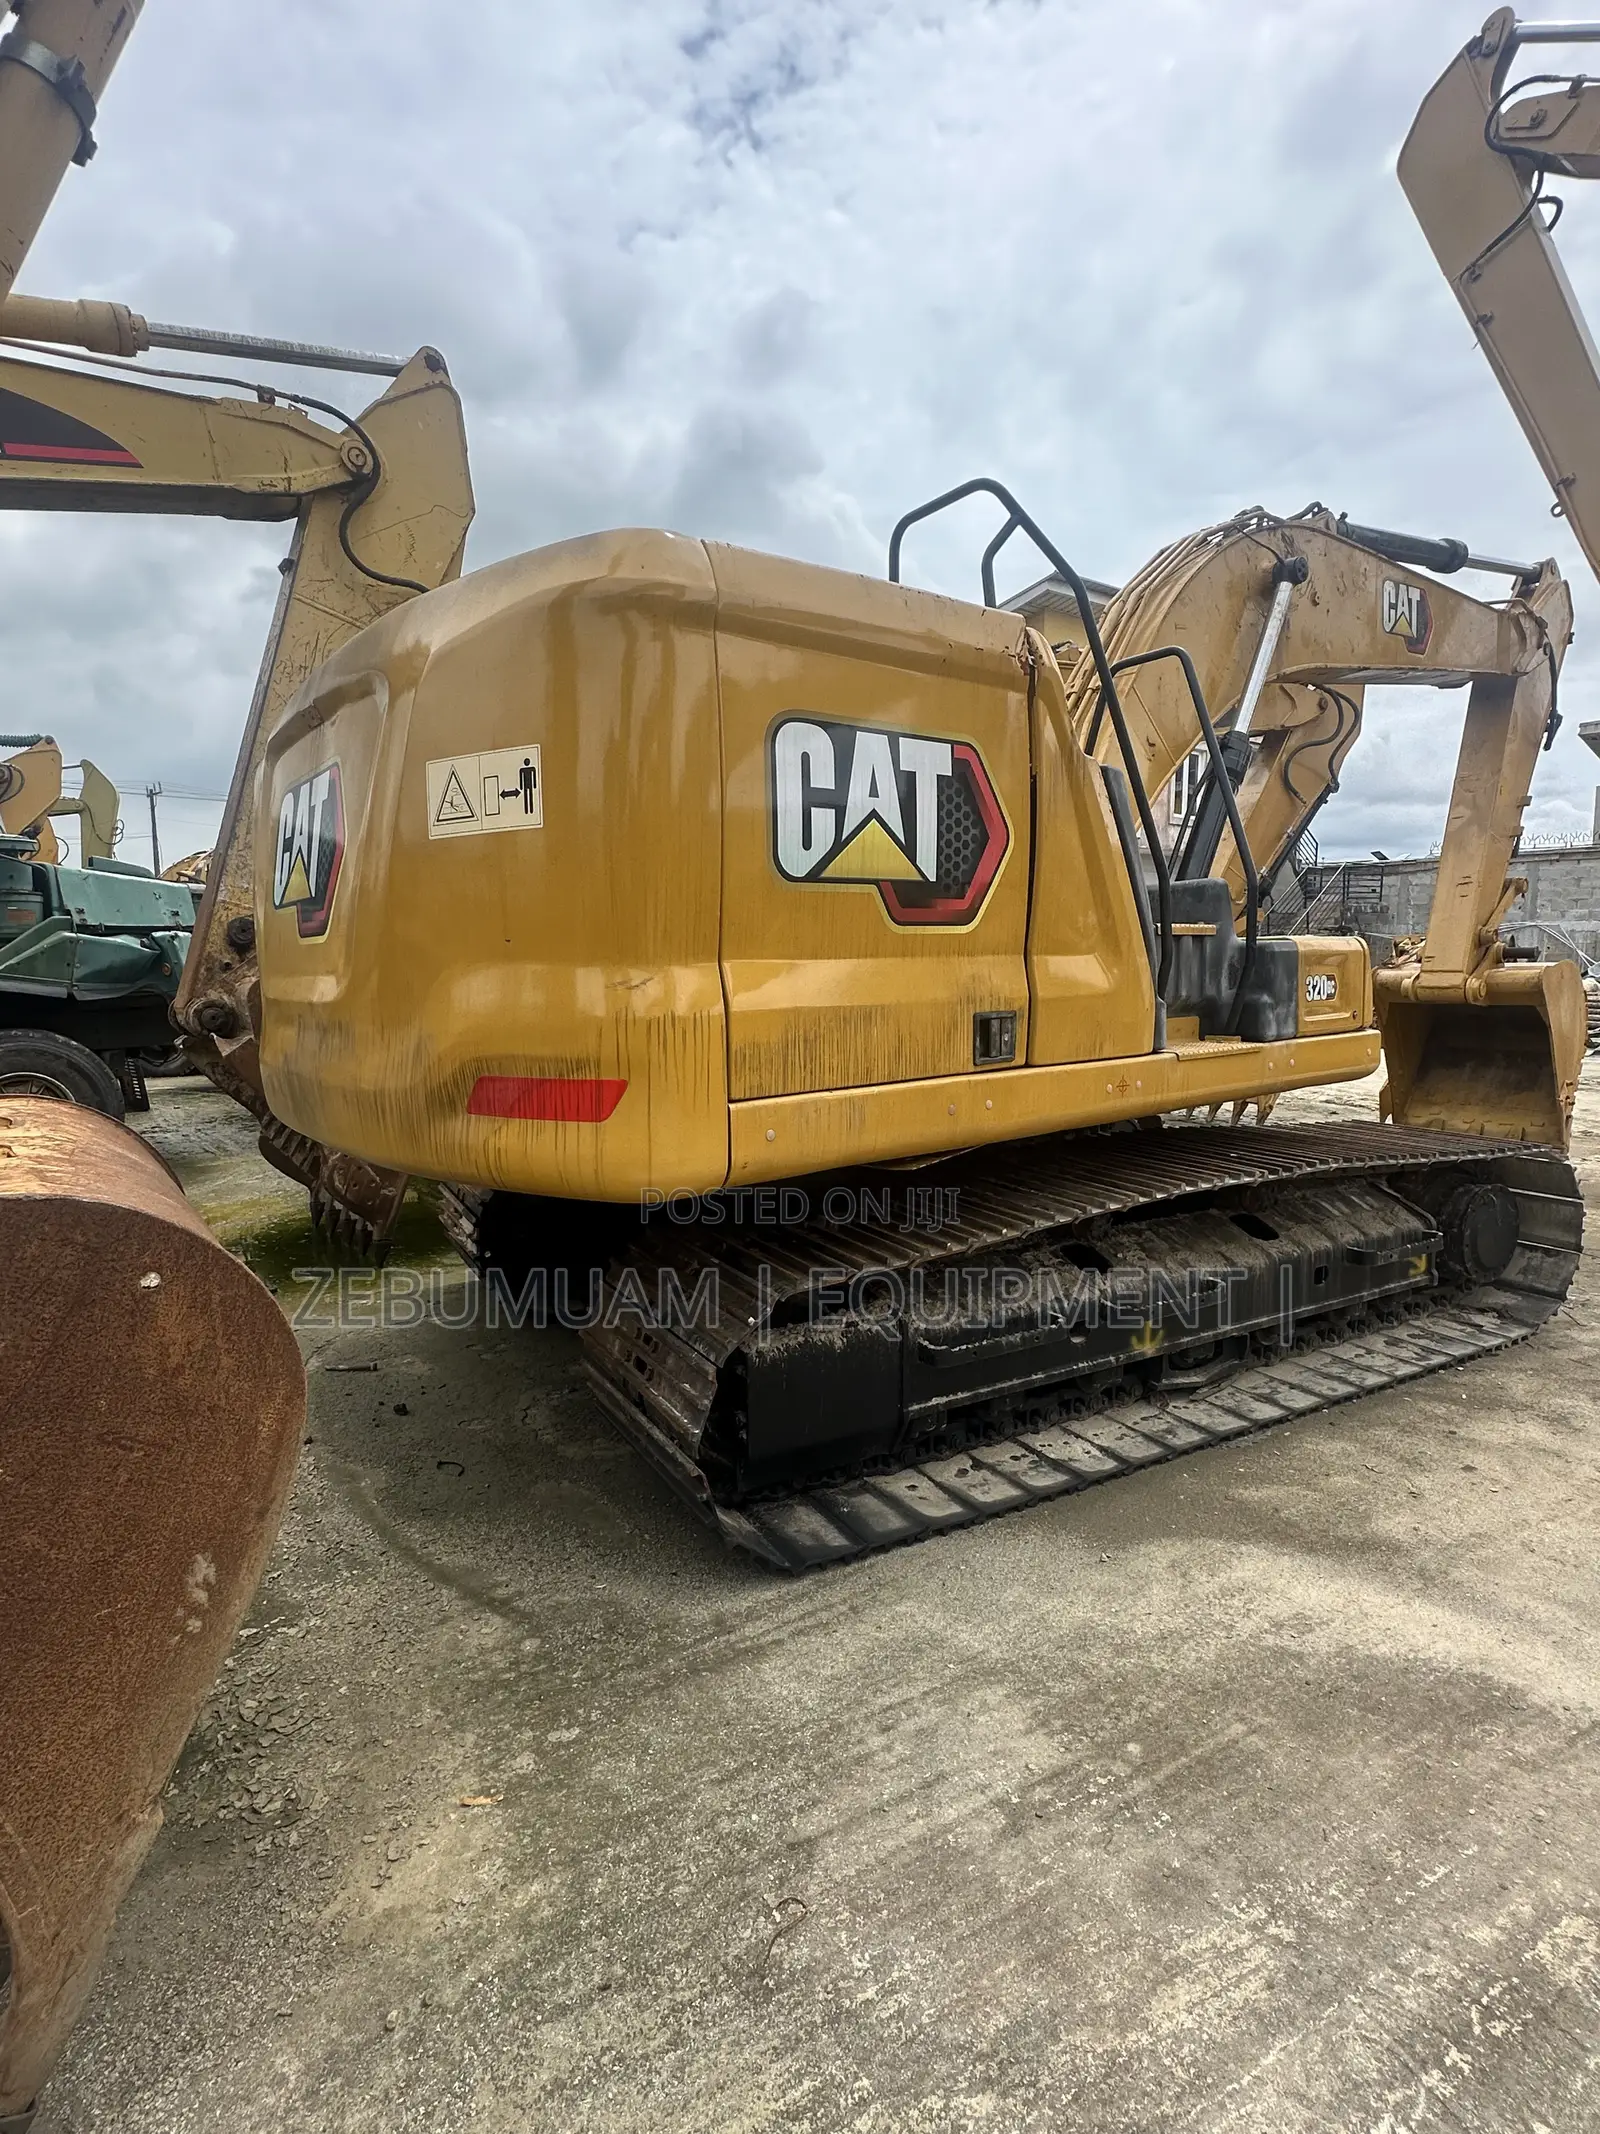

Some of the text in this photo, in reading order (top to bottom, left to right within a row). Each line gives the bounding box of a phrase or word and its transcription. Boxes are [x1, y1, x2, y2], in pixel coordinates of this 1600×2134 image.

[1383, 580, 1421, 638] CAT
[274, 769, 331, 906] CAT
[774, 721, 953, 883] CAT
